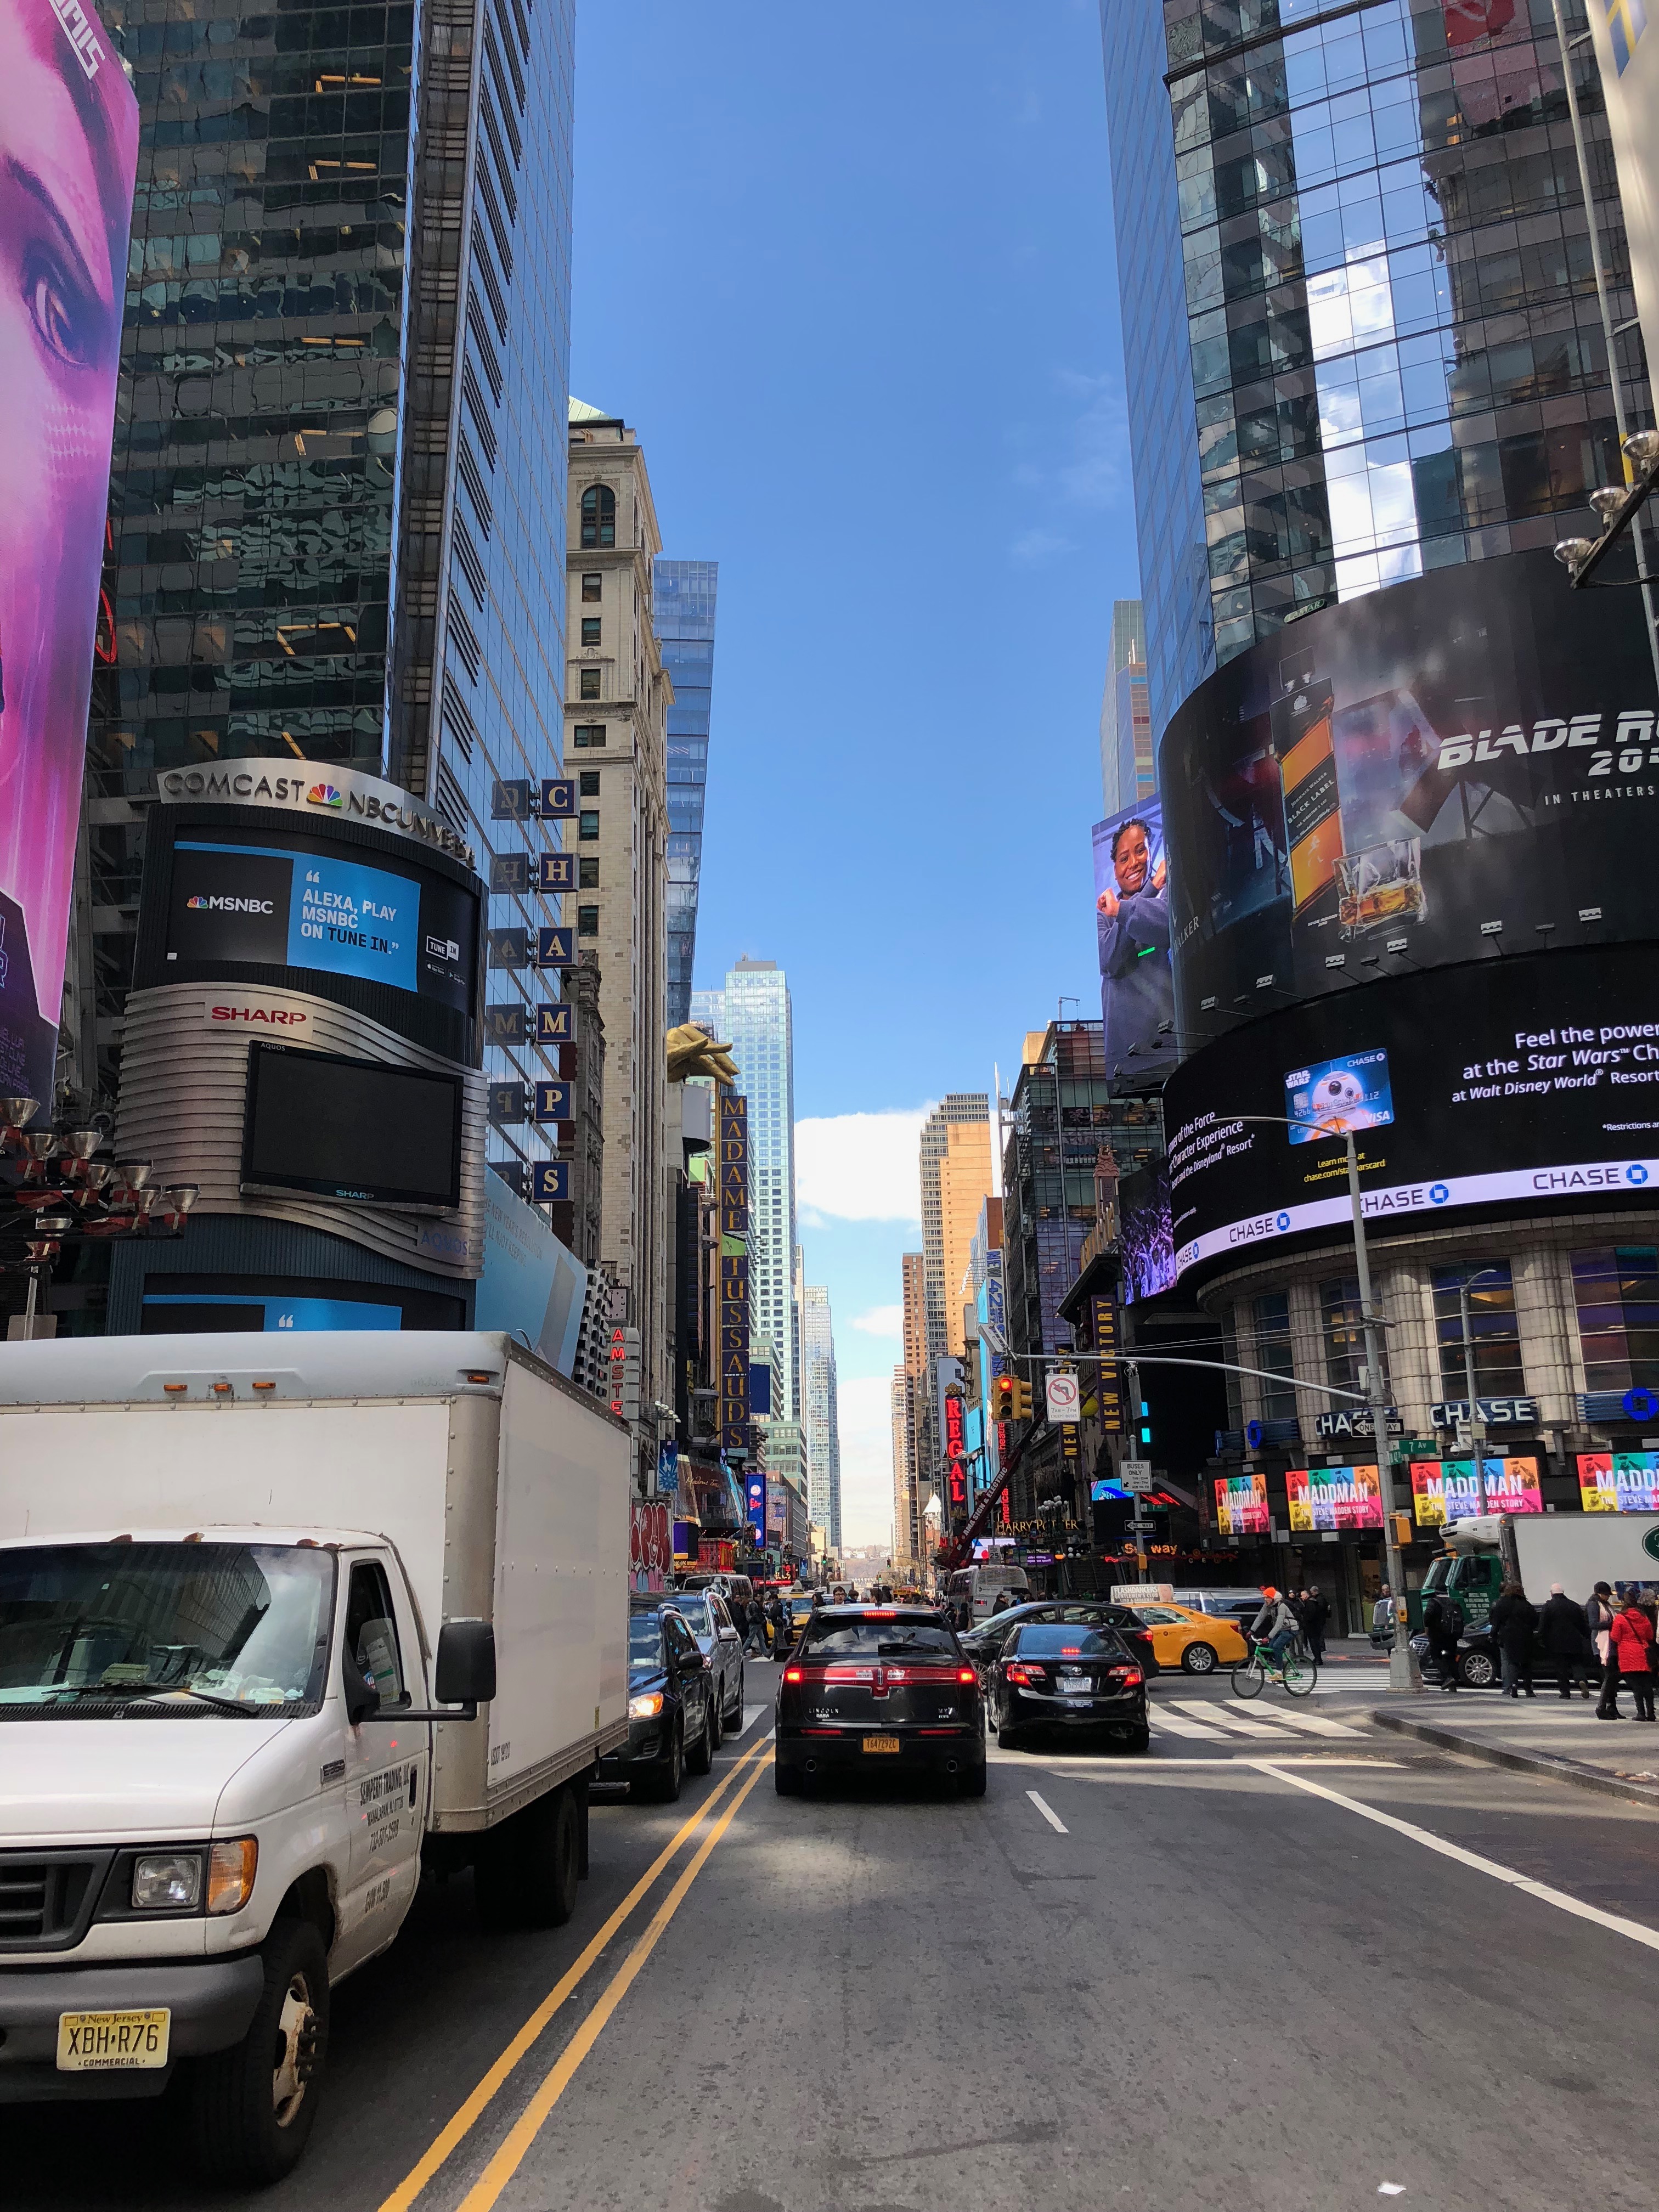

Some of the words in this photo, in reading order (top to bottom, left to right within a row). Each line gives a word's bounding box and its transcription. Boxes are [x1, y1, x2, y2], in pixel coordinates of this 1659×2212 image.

[1437, 714, 1602, 770] BLADE
[1616, 710, 1659, 743] R
[163, 772, 306, 802] COMCAST
[1544, 794, 1560, 806] IN
[1571, 785, 1655, 802] THEATERS
[1288, 800, 1311, 824] BLACK
[1311, 779, 1335, 802] LABEL
[208, 896, 274, 915] MSNBC
[302, 888, 358, 915] ALEXA,
[362, 900, 397, 922] PLAY
[302, 905, 358, 929] MSNBC
[301, 922, 323, 939] ON
[327, 927, 367, 948] TUNE
[430, 941, 445, 955] TUNE
[450, 945, 456, 955] IN
[211, 1006, 307, 1025] SHARP
[261, 1042, 286, 1051] AQUOS
[1515, 1029, 1556, 1049] Feel
[1561, 1026, 1595, 1043] the
[1347, 1054, 1376, 1068] CHASE
[1463, 1064, 1483, 1080] at
[1486, 1059, 1519, 1076] the
[1527, 1052, 1567, 1071] Star
[1285, 1069, 1311, 1084] STAR
[1285, 1075, 1311, 1089] WARS
[1452, 1090, 1466, 1103] at
[1469, 1084, 1502, 1099] Walt
[1504, 1080, 1552, 1096] Disney
[1178, 1126, 1183, 1143] of
[1183, 1123, 1194, 1138] the
[1194, 1111, 1215, 1131] Force
[1364, 1110, 1390, 1124] VISA
[1173, 1142, 1196, 1169] Character
[1196, 1121, 1244, 1151] Experience
[724, 1097, 745, 1229] MADAME
[1317, 1158, 1337, 1169] Learn
[1357, 1152, 1367, 1160] at
[1532, 1167, 1622, 1190] CHASE
[336, 1189, 375, 1200] SHARP
[1229, 1217, 1274, 1243] CHASE
[986, 1250, 1002, 1278] NEW
[1177, 1246, 1193, 1269] CHASE
[1096, 1301, 1117, 1380] VICTORY
[1103, 1392, 1121, 1430] NEW
[1315, 1409, 1390, 1436] CHA
[1430, 1400, 1534, 1426] CHASE
[946, 1399, 965, 1502] REGAL
[1063, 1424, 1078, 1456] NEW
[1409, 1442, 1414, 1453] 7
[1426, 1475, 1523, 1499] MADDMAN
[1595, 1469, 1659, 1493] MADD
[963, 1520, 976, 1536] AMA
[972, 1502, 986, 1520] SIGN
[986, 1466, 1008, 1498] ELECTRIC
[1221, 1489, 1261, 1511] MADDMAN
[1297, 1482, 1369, 1505] MADDMAN
[1447, 1501, 1468, 1510] STEVE
[1500, 1498, 1523, 1508] STORY
[1618, 1494, 1642, 1504] STEVE
[1312, 1507, 1329, 1516] STEVE
[1330, 1506, 1351, 1515] MADDEN
[1352, 1505, 1369, 1514] STORY
[997, 1520, 1034, 1533] HARRY
[1124, 1542, 1178, 1555] Sway
[87, 2014, 110, 2024] New
[111, 2013, 143, 2025] Jersey
[83, 2057, 140, 2067] COMMERCIAL
